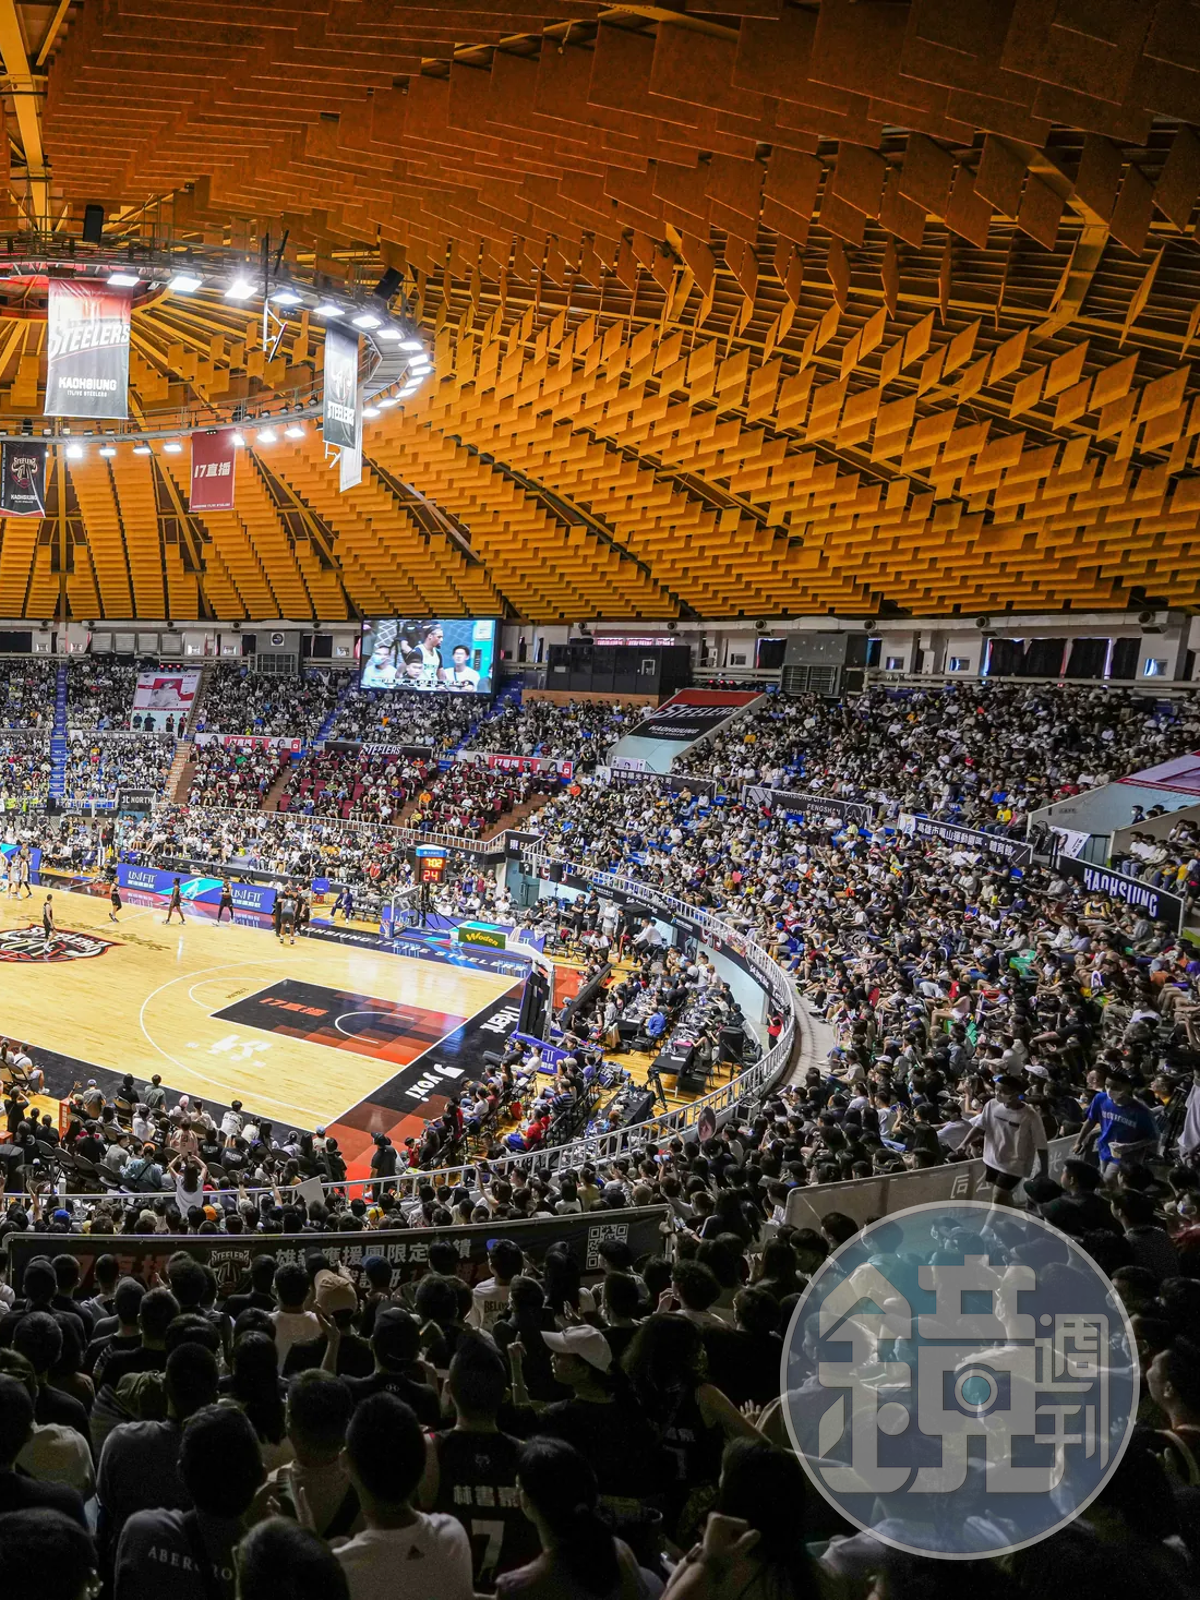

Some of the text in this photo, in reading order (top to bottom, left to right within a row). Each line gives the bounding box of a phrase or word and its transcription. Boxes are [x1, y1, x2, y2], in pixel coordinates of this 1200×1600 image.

[58, 376, 118, 391] KAOHSIUNG
[194, 462, 231, 478] 17直播
[423, 870, 439, 881] 24
[1084, 867, 1159, 918] KAOHSIUNG
[465, 931, 500, 948] Woden
[471, 1519, 506, 1579] 7
